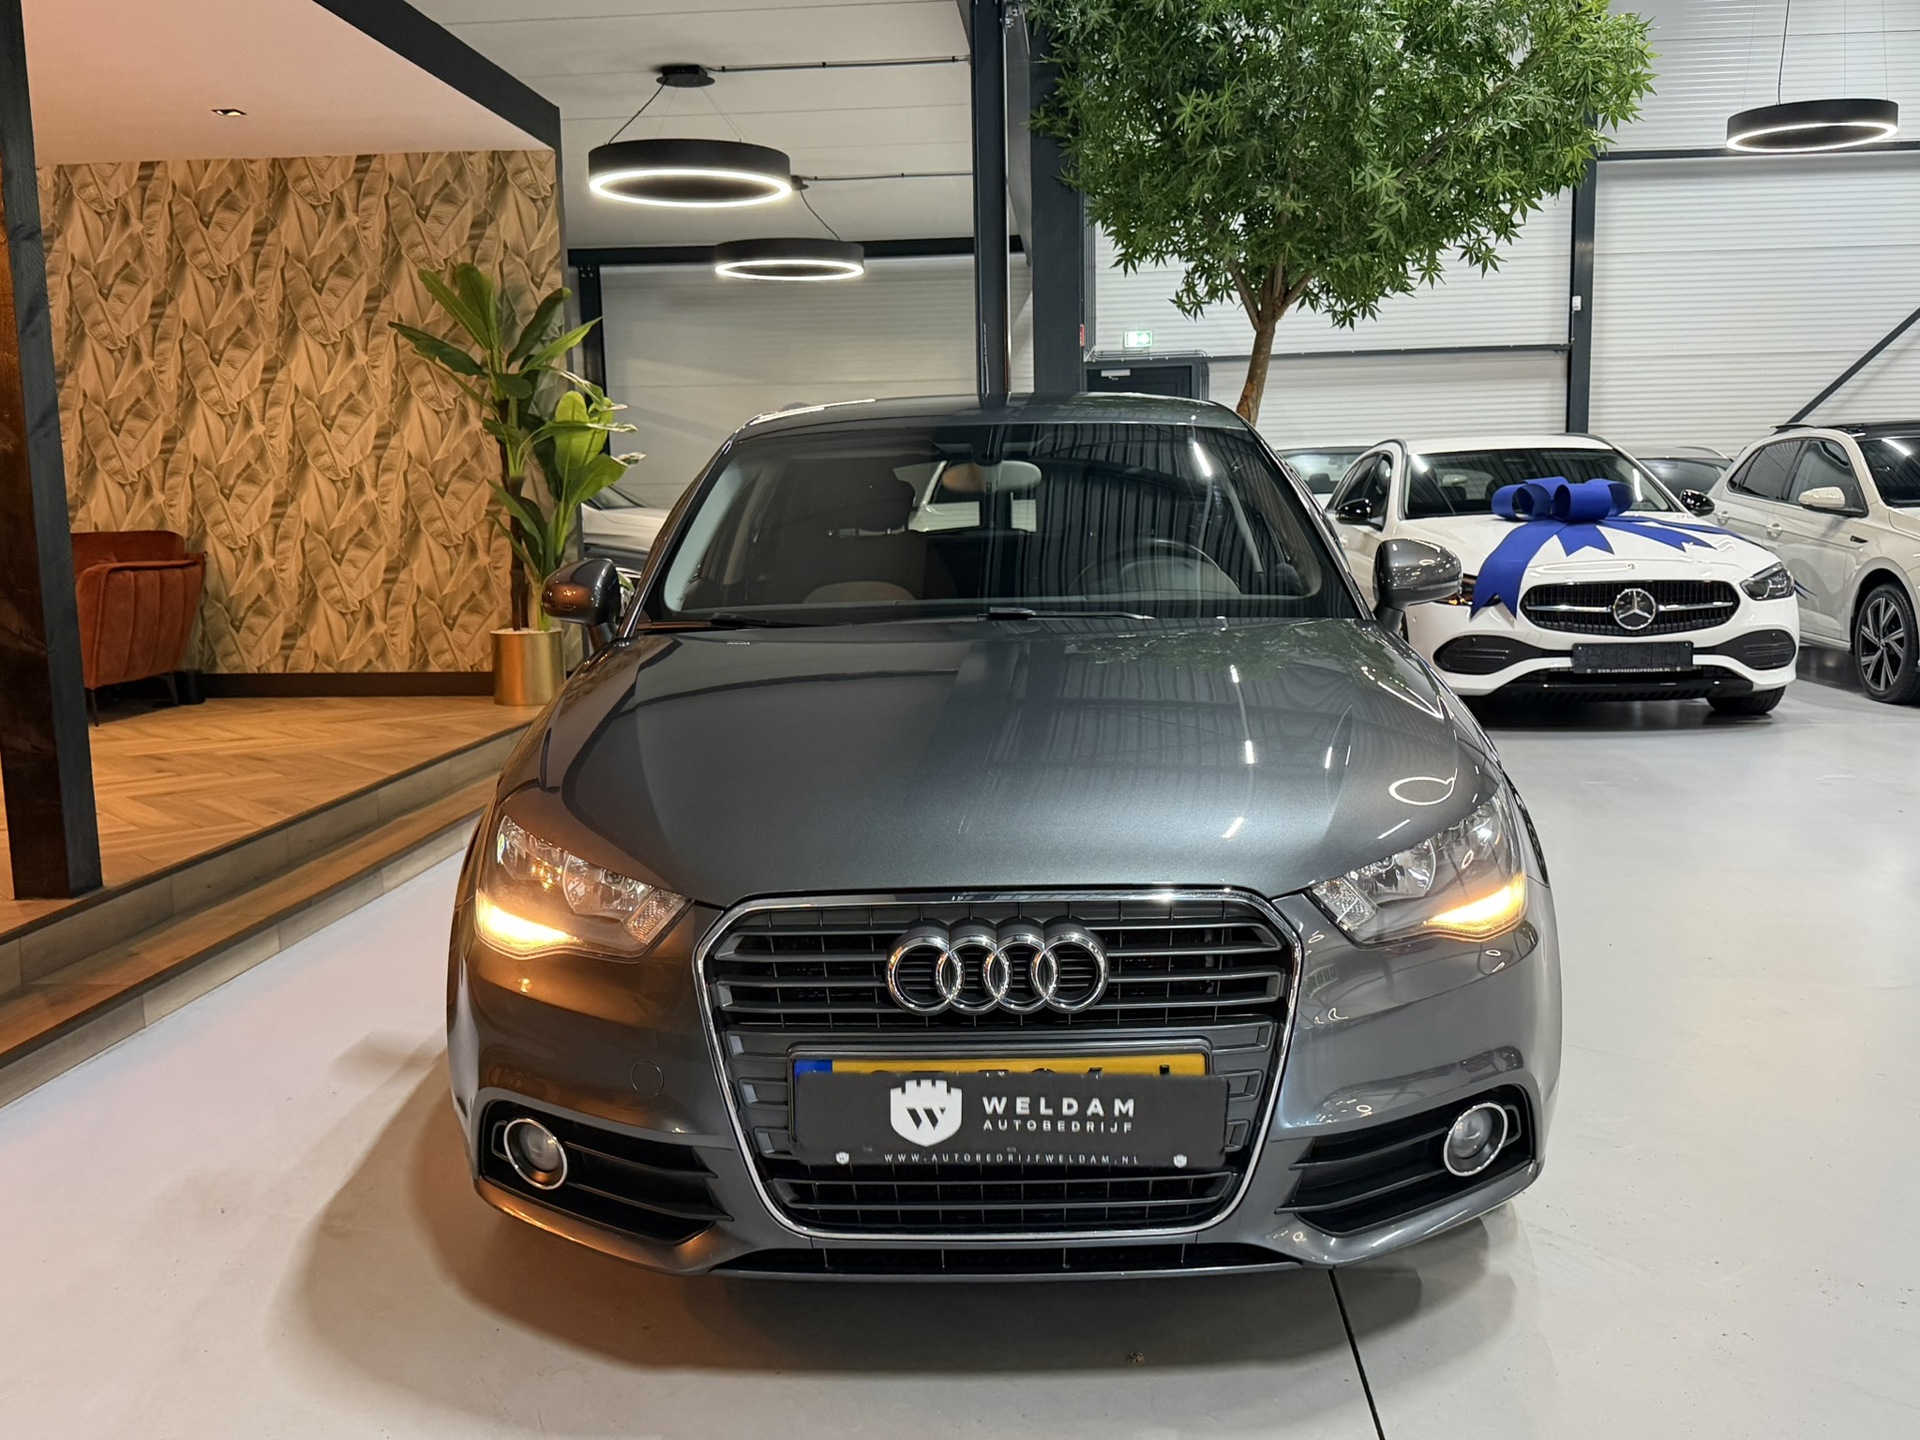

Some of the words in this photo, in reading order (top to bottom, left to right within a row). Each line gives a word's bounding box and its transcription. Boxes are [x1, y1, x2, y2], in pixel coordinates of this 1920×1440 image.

[981, 1096, 1135, 1118] WELDAM
[983, 1119, 1133, 1133] AUTOBEDRIJF
[884, 1153, 1139, 1165] WWW.AUTOBEDRIJFWELDAM.NL
